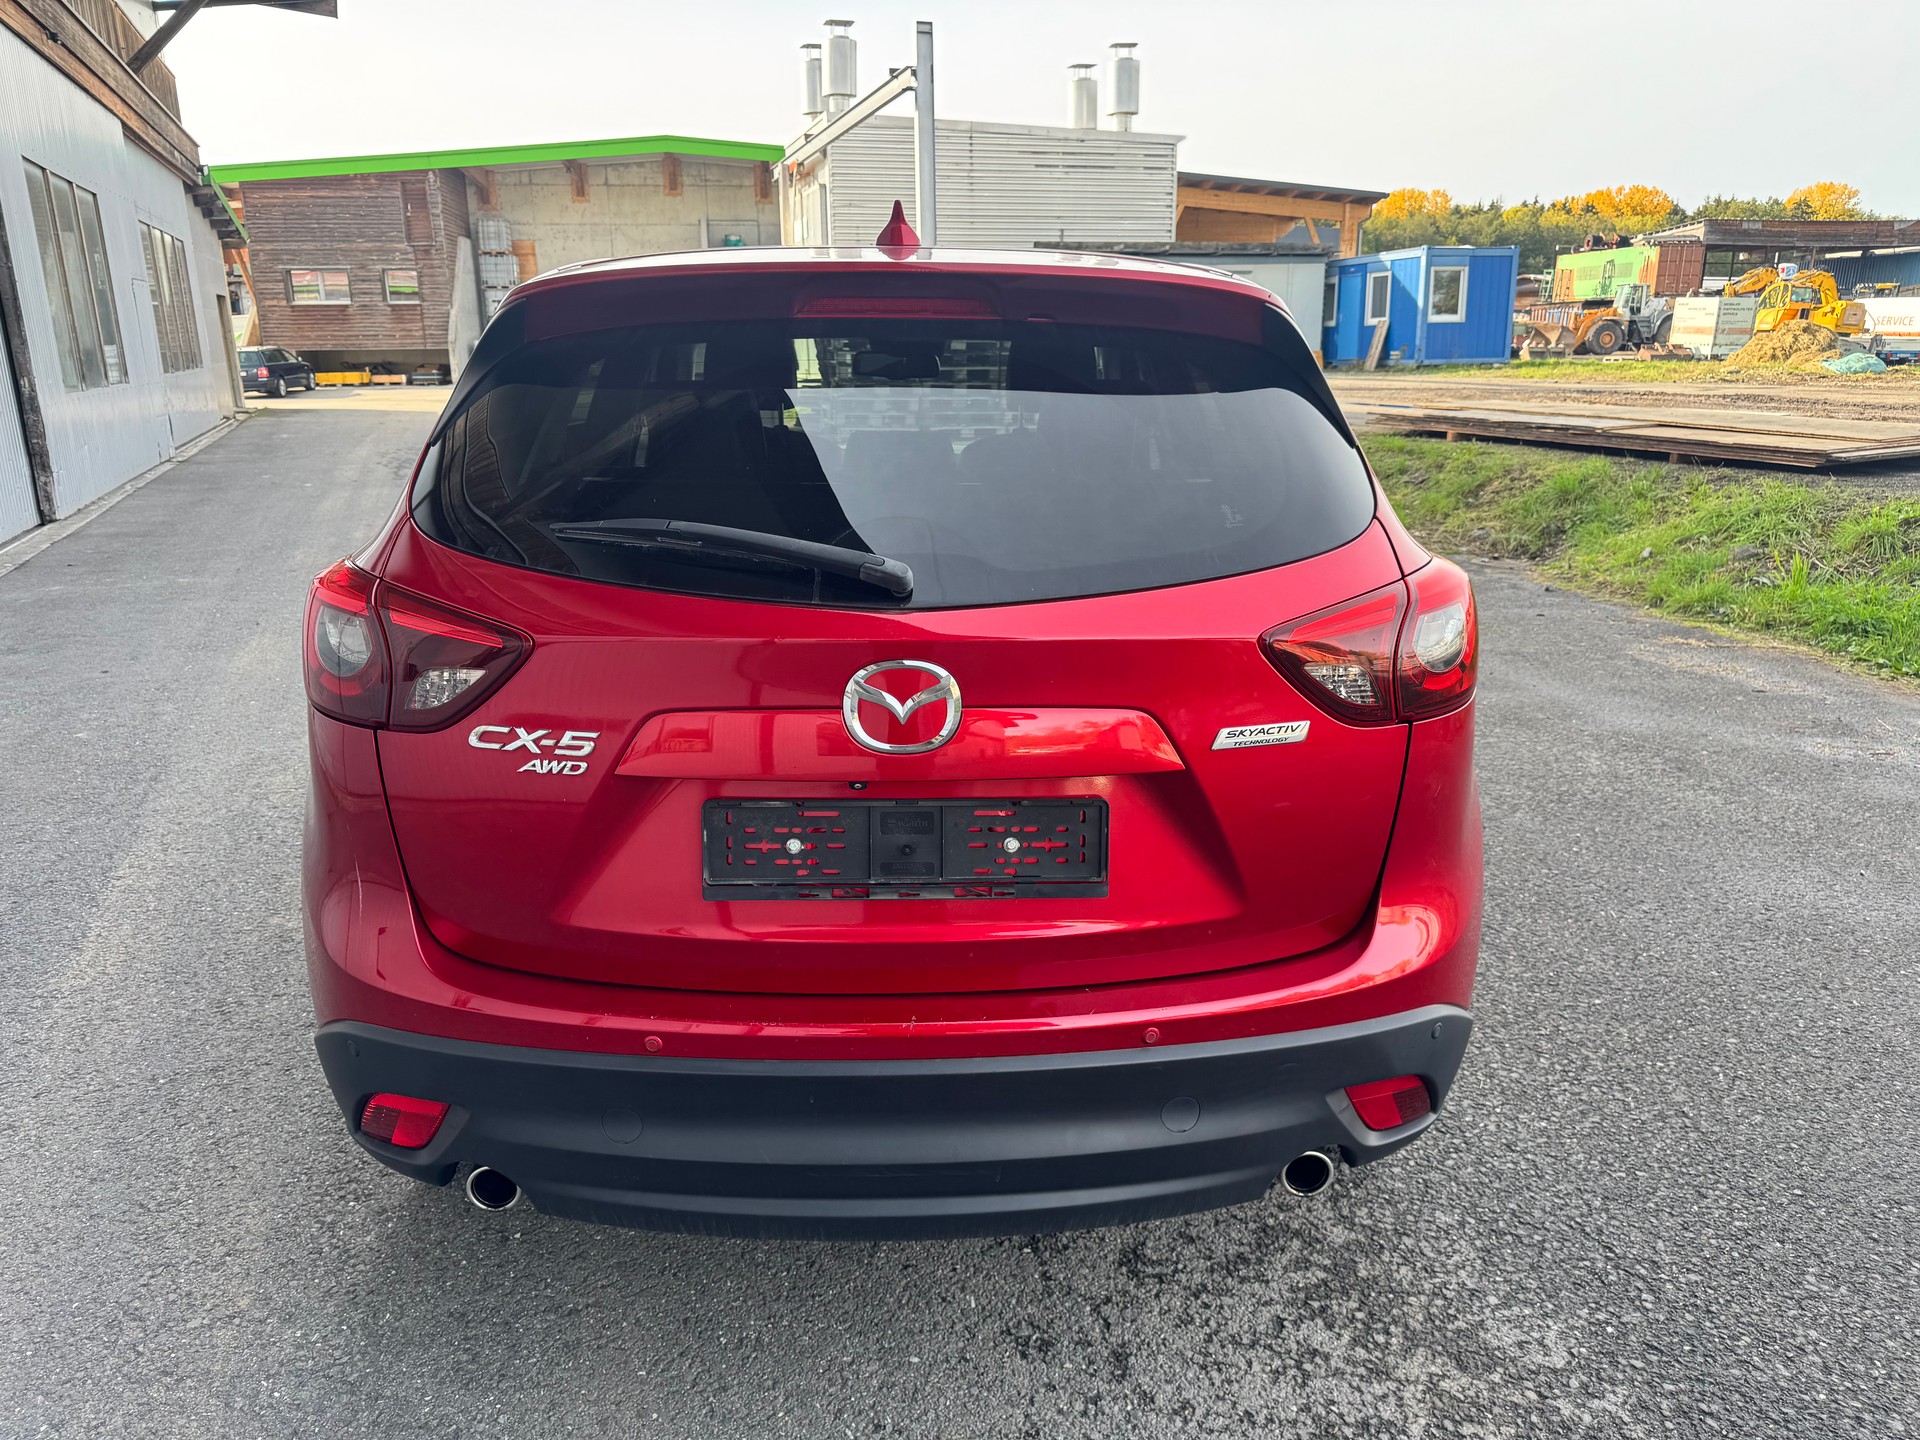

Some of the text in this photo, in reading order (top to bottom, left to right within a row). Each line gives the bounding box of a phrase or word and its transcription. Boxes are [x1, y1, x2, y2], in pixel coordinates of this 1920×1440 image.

[1876, 316, 1914, 326] SERVICE
[1225, 724, 1301, 739] SKYACTIV
[468, 725, 600, 756] CX-5
[1233, 737, 1290, 747] TECHNOLOGY
[517, 759, 588, 775] AWD
